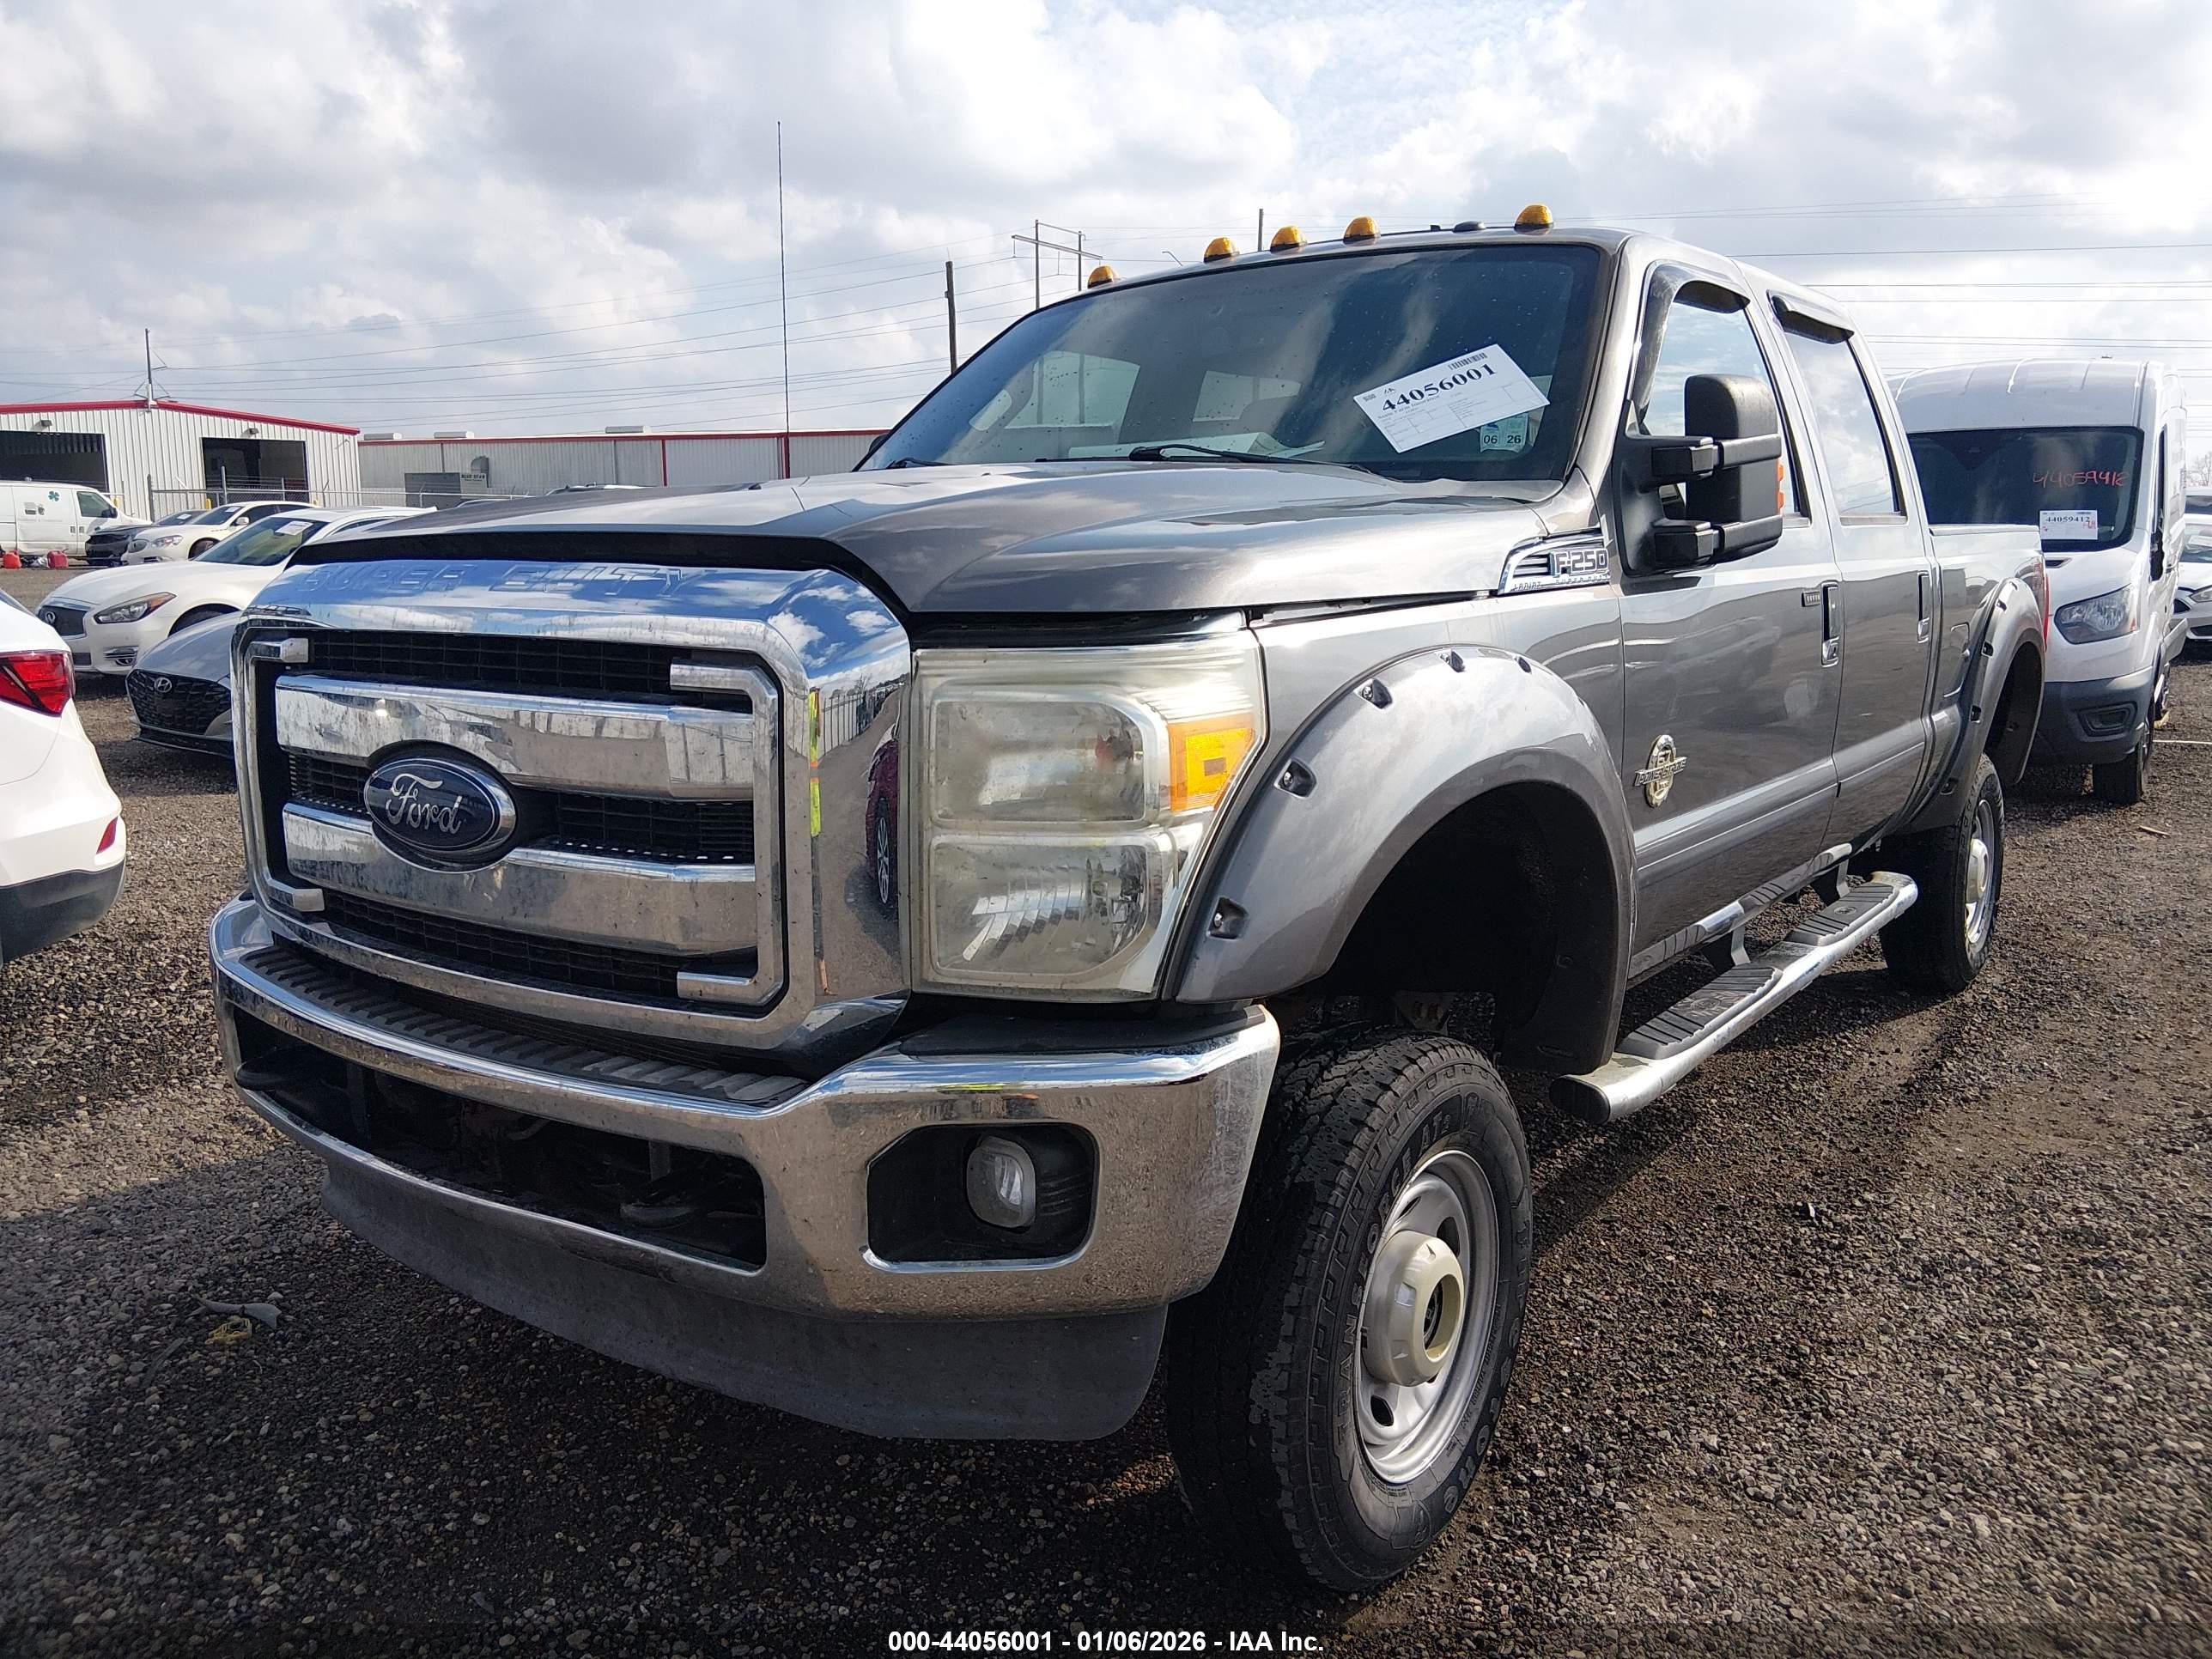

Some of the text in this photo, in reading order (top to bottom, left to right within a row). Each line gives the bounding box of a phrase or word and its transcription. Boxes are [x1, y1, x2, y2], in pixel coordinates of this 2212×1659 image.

[1382, 363, 1497, 411] 44056001
[1483, 434, 1522, 444] 06 26
[300, 563, 706, 599] SUPER DUTY
[385, 772, 463, 836] Ford
